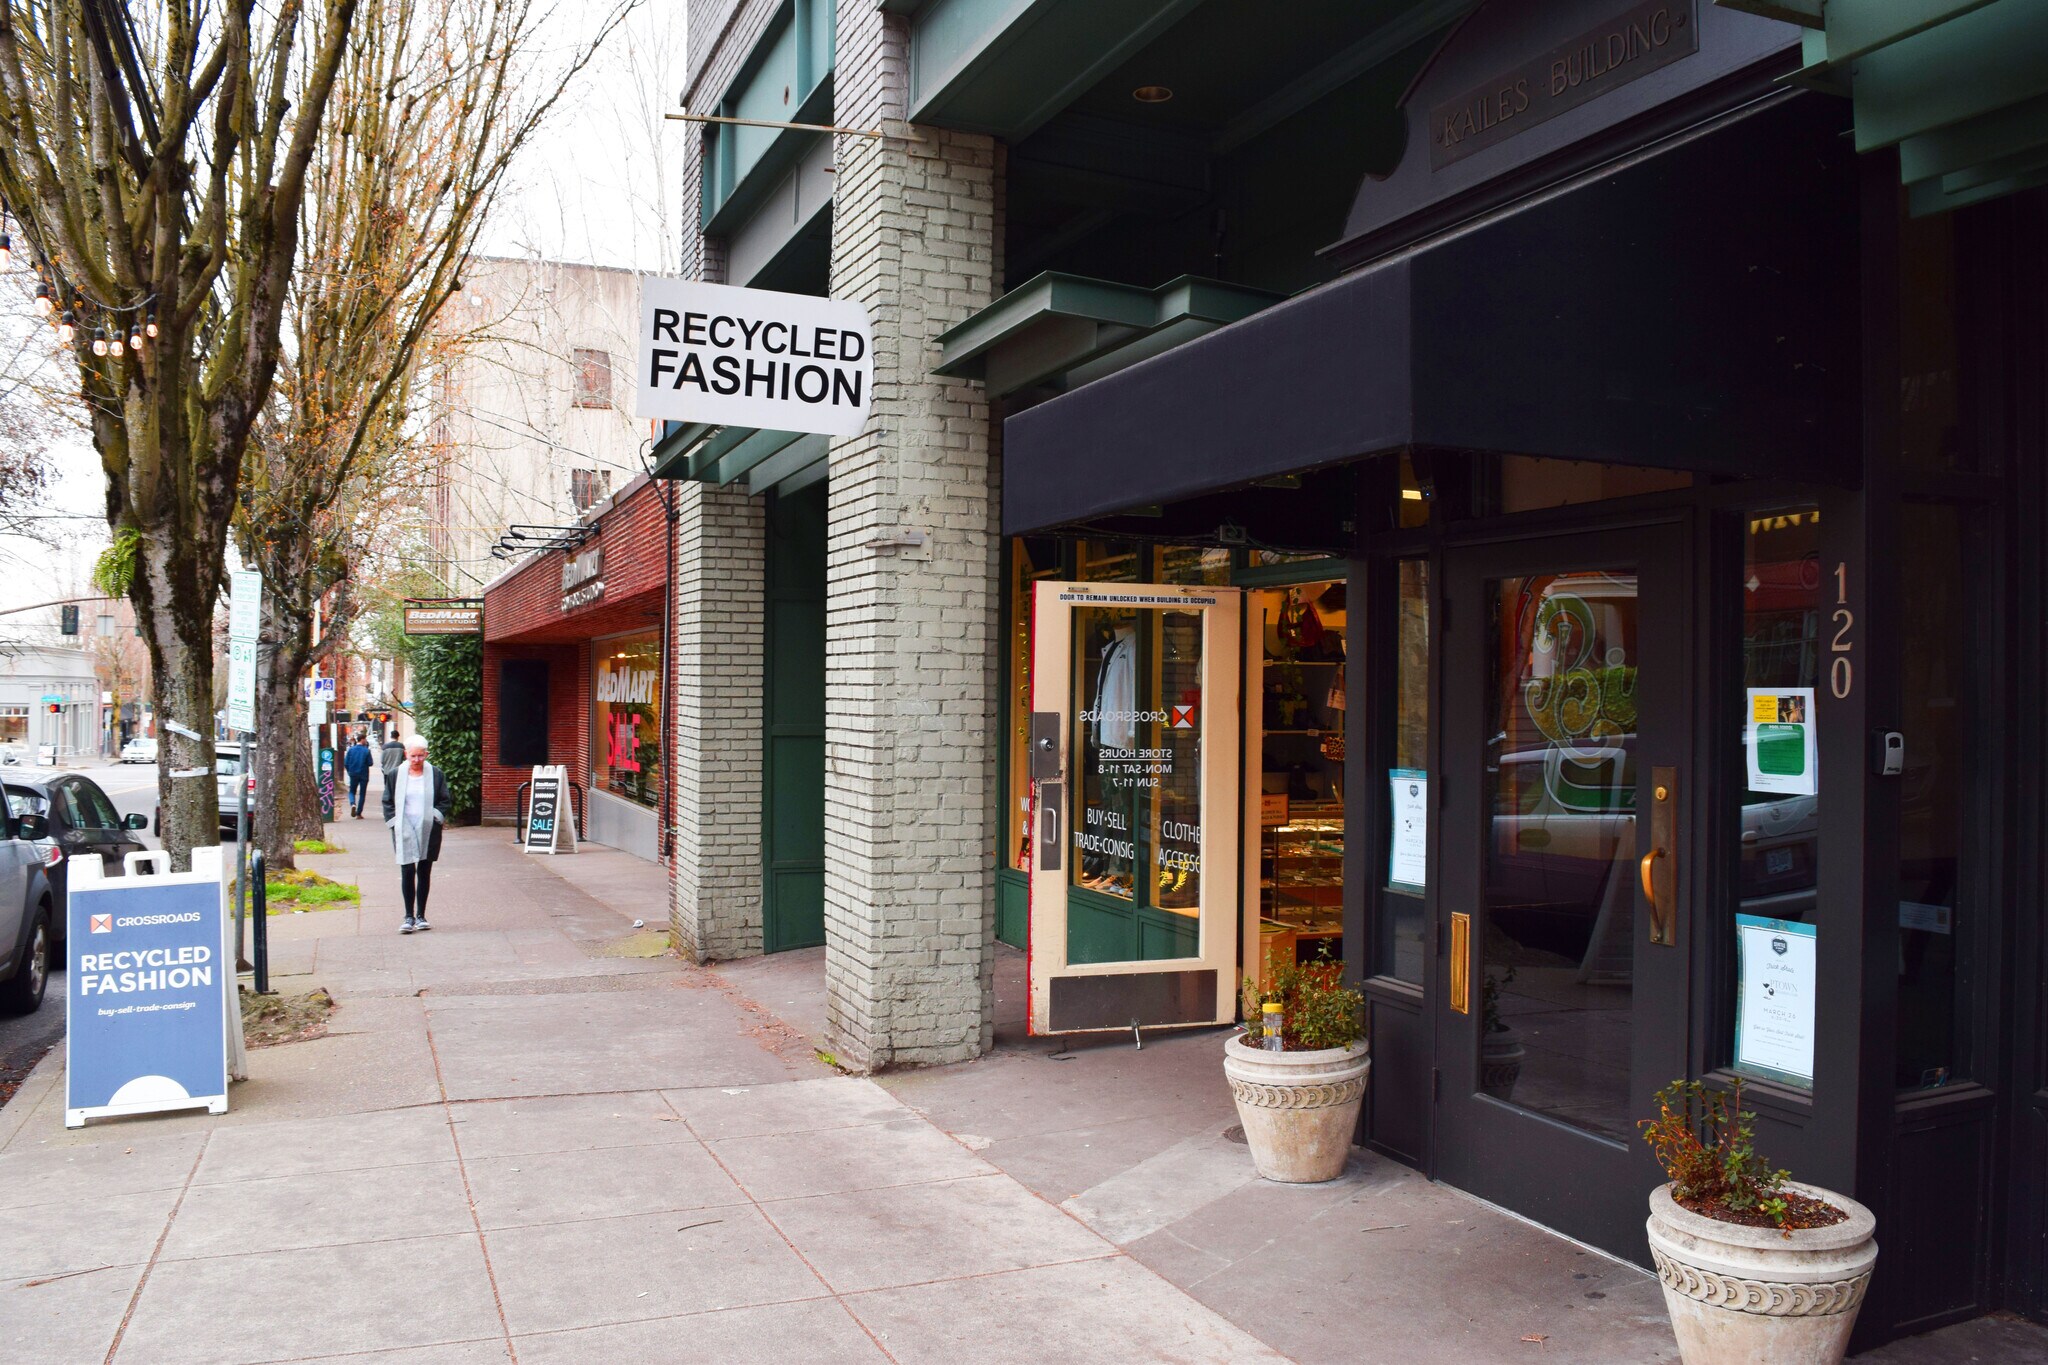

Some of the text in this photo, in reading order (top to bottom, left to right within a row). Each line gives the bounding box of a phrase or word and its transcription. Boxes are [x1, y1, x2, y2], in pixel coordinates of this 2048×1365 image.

[1443, 8, 1673, 148] KAILES BUILDING
[652, 308, 865, 362] RECYCLED
[650, 348, 863, 408] FASHION
[1109, 595, 1137, 603] UNLOCKED
[1190, 597, 1216, 605] OCCUPIED
[1830, 562, 1854, 699] 120
[606, 712, 641, 773] SALE
[531, 818, 553, 831] SALE
[116, 912, 201, 928] CROSSROADS
[81, 946, 211, 972] RECYCLED
[81, 966, 212, 996] FASHION
[1770, 979, 1798, 993] PTOWN
[1763, 1007, 1786, 1017] MARCH
